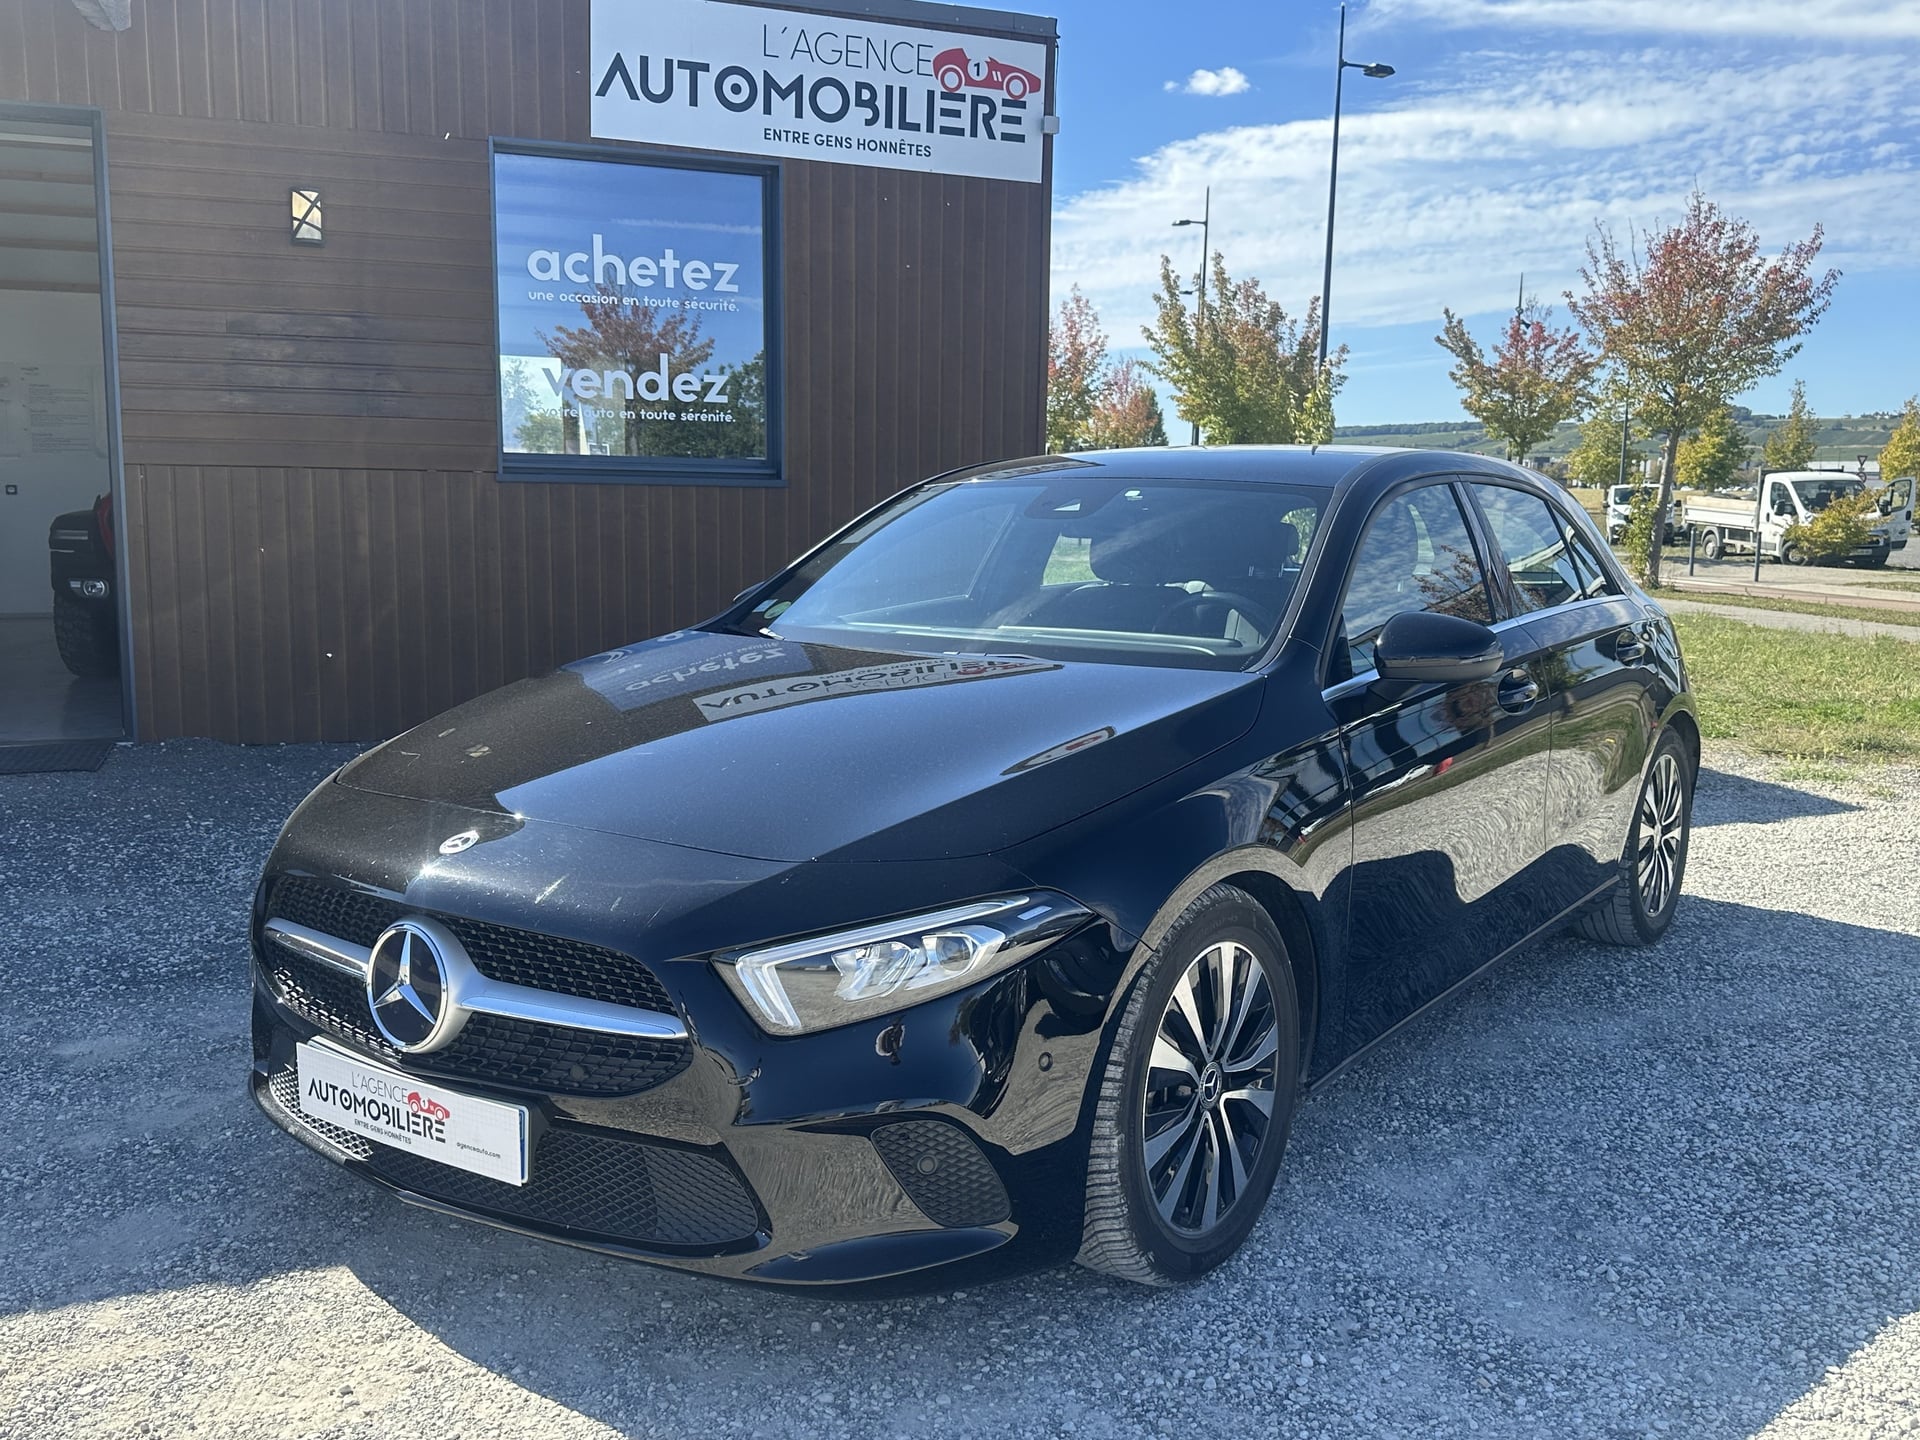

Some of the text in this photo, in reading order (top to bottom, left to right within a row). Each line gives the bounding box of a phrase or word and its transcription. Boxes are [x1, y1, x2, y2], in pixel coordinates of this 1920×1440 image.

[762, 23, 934, 77] L'AGENCE
[973, 62, 982, 77] 1
[595, 51, 1027, 144] AUTOMOBILIERE
[763, 127, 932, 158] ENTRE GENS HONNÊTES
[527, 233, 740, 293] achetez
[528, 291, 740, 312] une occasion en toute sécurité.
[542, 352, 729, 404] vendez
[584, 408, 615, 419] auto
[619, 410, 636, 420] en
[640, 409, 676, 421] toute
[680, 409, 736, 423] sérénité.
[354, 1118, 370, 1130] ENTRE
[370, 1123, 384, 1135] GENS
[456, 1141, 502, 1159] agenceauto.com
